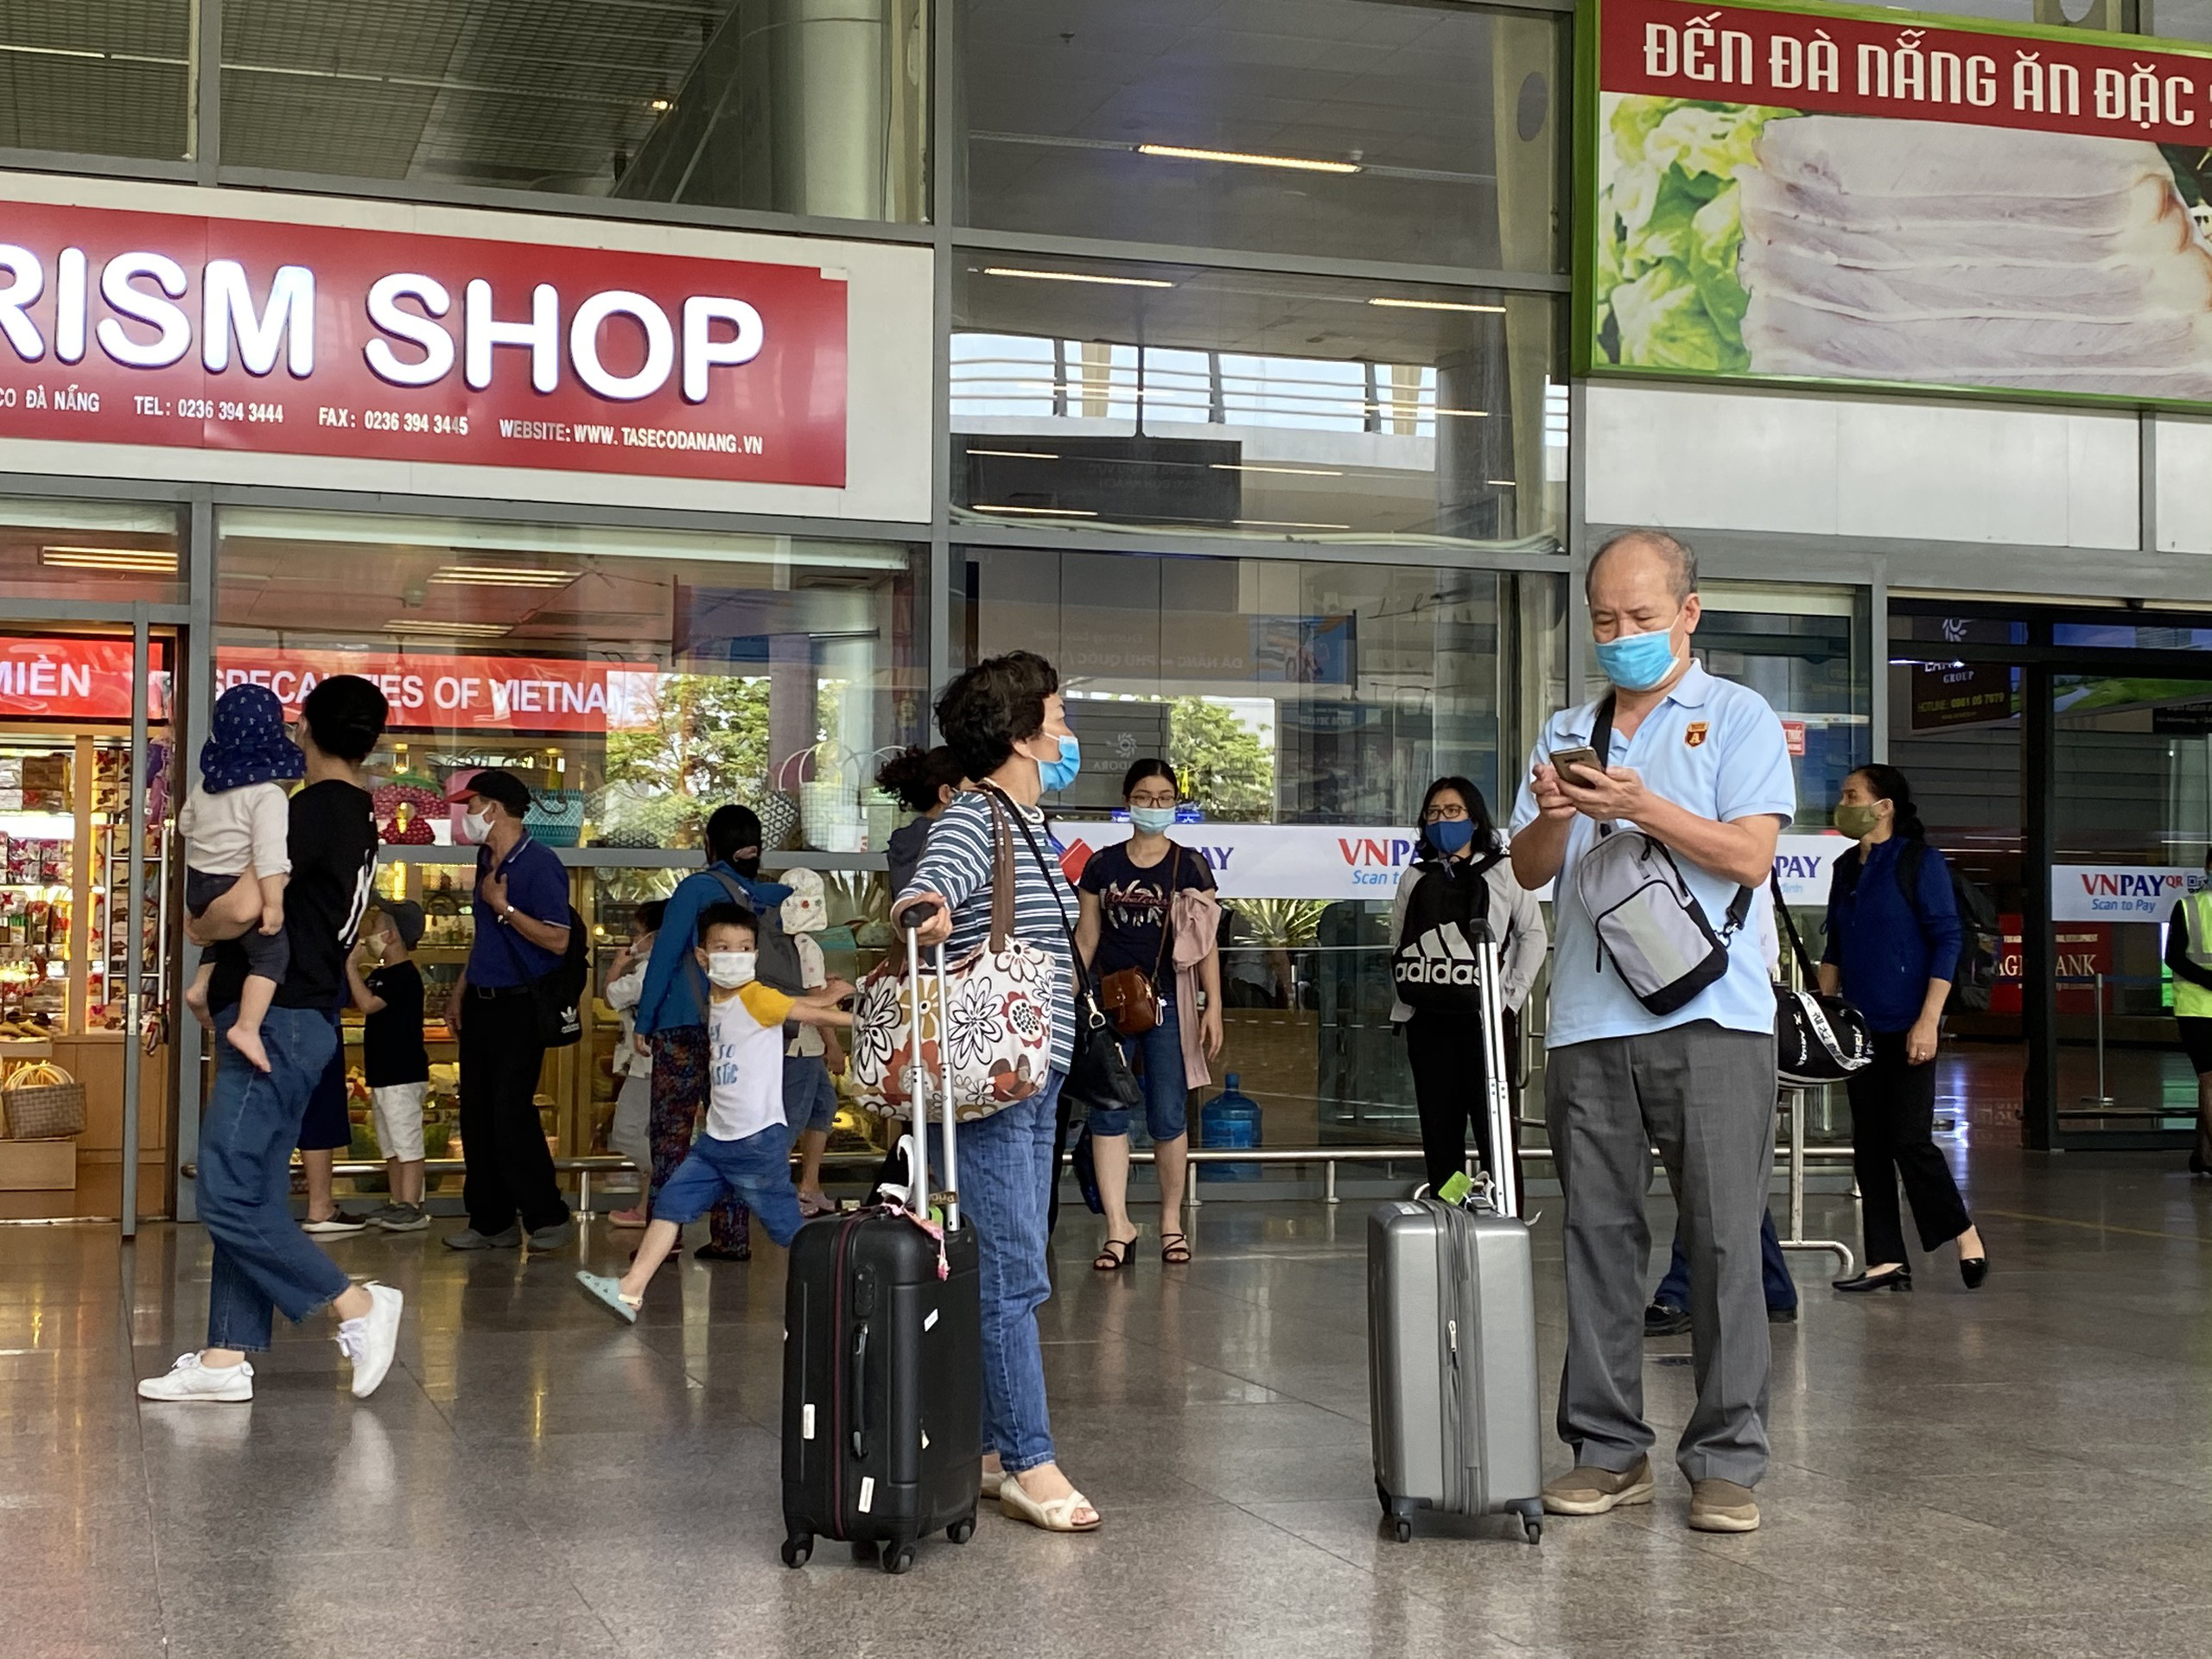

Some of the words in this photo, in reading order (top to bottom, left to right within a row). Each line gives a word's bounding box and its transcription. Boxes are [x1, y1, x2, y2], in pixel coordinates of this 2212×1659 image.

[1643, 11, 1753, 85] ĐẾN
[1769, 29, 1839, 92] ĐÀ
[1858, 29, 1997, 107] NẴNG
[2013, 49, 2080, 116] ĂN
[2094, 61, 2195, 130] ĐẶC
[362, 272, 766, 405] SHOP
[25, 384, 48, 410] ĐÀ
[134, 395, 171, 416] TEL:
[178, 398, 213, 418] 0236
[218, 401, 244, 421] 394
[248, 402, 283, 423] 3444
[319, 406, 356, 428] FAX:
[365, 410, 399, 431] 0236
[404, 413, 429, 432] 394
[434, 415, 468, 435] 3445
[499, 419, 571, 442] WEBSITE:
[434, 677, 480, 709] OF
[1338, 838, 1423, 866] VNP
[1775, 855, 1822, 878] PAY
[1352, 870, 1388, 885] Scan
[2092, 899, 2118, 911] Scan
[2122, 899, 2133, 911] to
[2136, 899, 2157, 913] Pay
